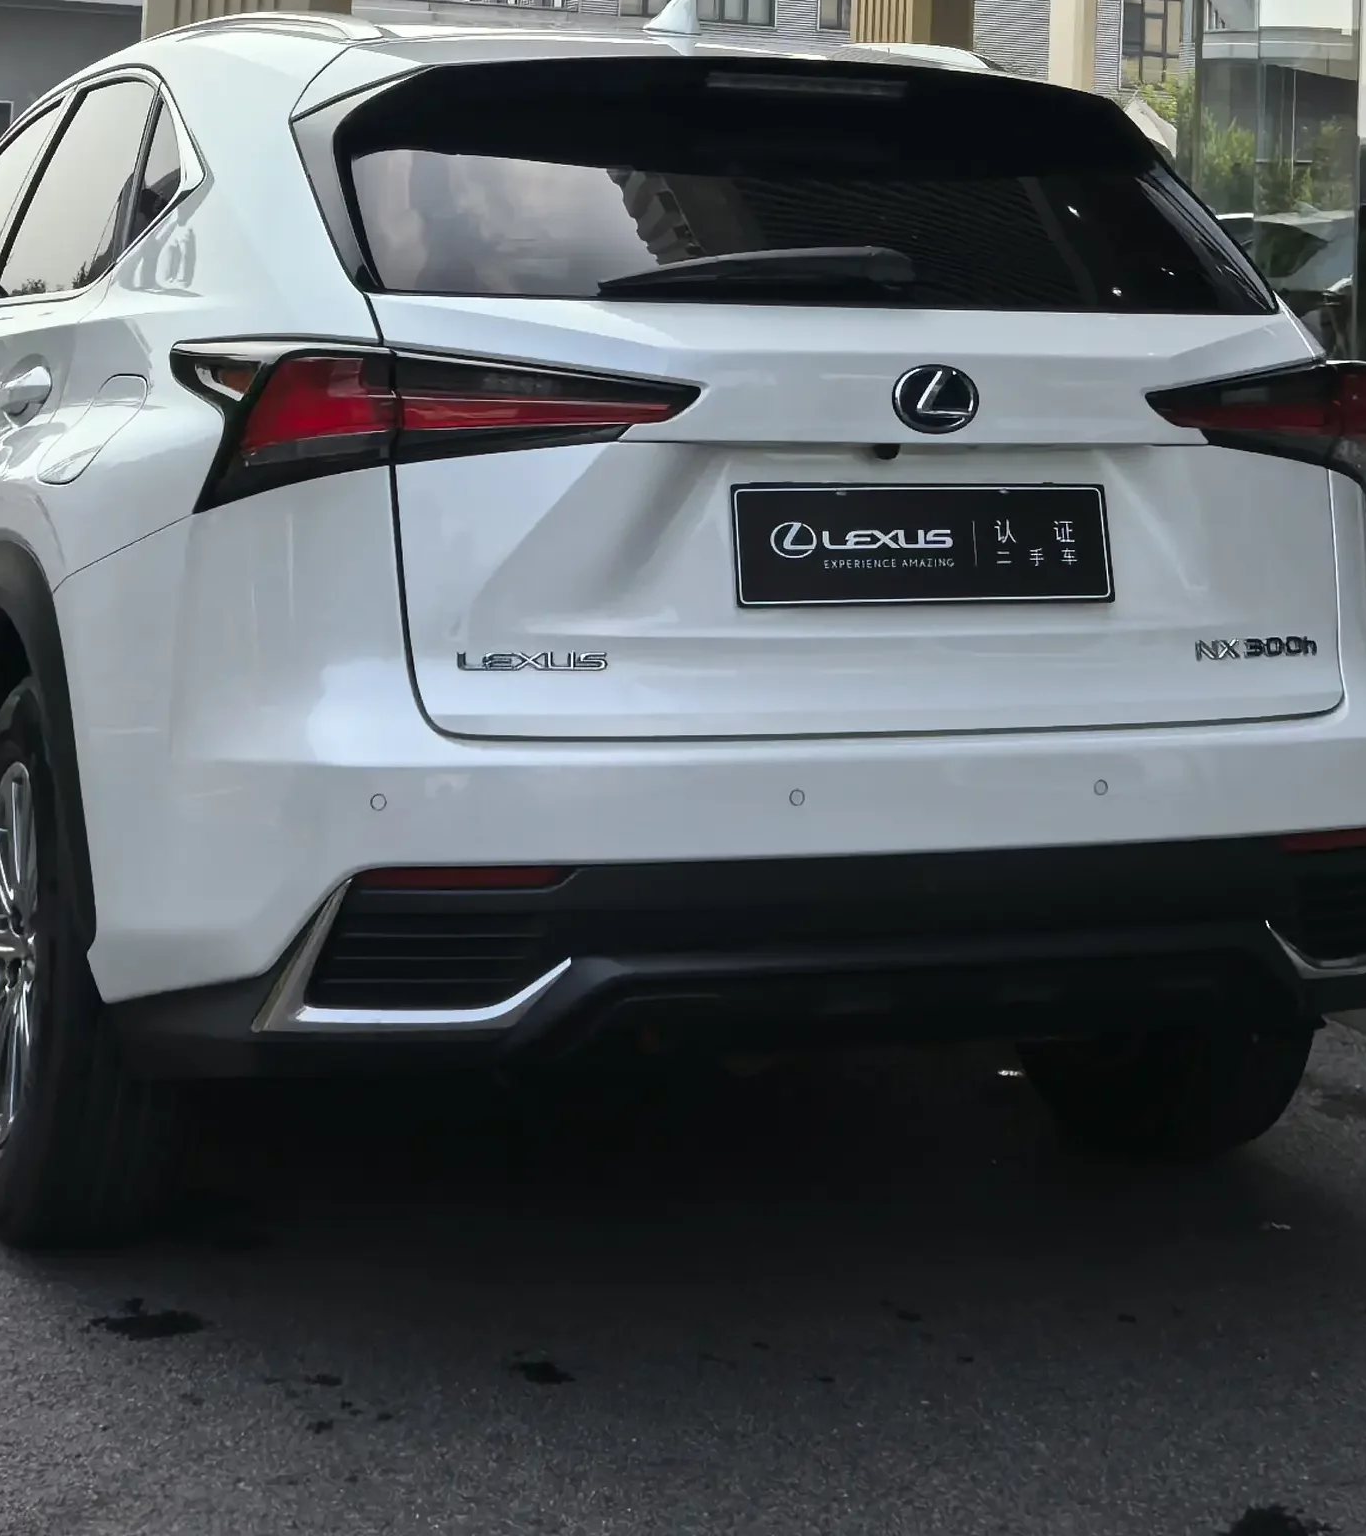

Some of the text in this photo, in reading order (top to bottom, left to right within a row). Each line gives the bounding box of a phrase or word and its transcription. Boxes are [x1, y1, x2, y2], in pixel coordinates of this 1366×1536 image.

[822, 529, 954, 551] LEXUS
[994, 519, 1076, 545] 认证
[823, 557, 955, 570] EXPERIENCE AMAZING
[996, 547, 1078, 567] 二手车
[456, 650, 608, 672] LEXUS
